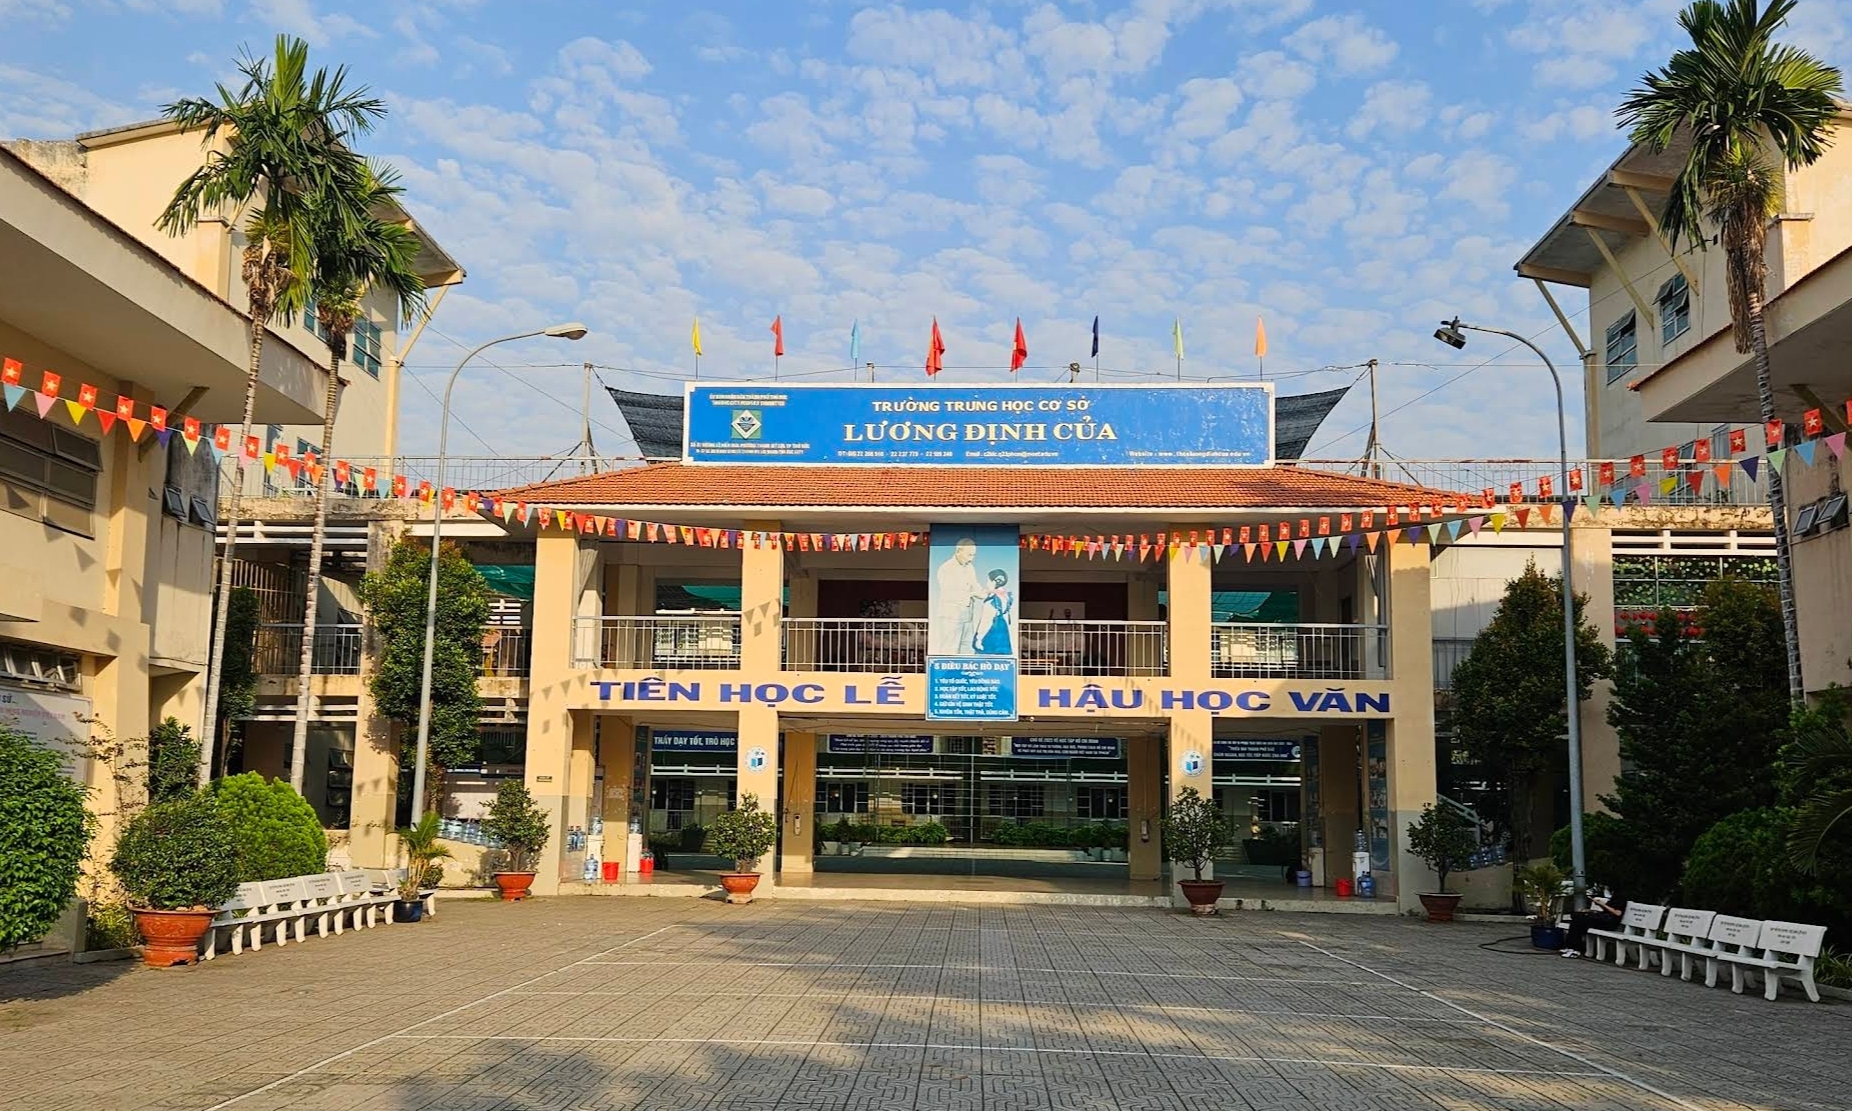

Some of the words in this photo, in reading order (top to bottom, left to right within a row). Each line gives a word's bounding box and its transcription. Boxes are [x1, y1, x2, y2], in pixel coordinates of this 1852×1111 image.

[872, 396, 940, 412] TRƯỜNG
[946, 400, 998, 412] TRUNG
[1002, 400, 1034, 415] HỌC
[1038, 399, 1063, 412] CƠ
[1066, 396, 1091, 411] SỞ
[844, 420, 959, 442] LƯƠNG
[964, 422, 1047, 446] ĐỊNH
[1052, 415, 1118, 441] CỦA
[934, 662, 940, 670] 5
[962, 661, 979, 670] BÁC
[980, 661, 992, 670] HỒ
[720, 683, 825, 708] HỌC
[844, 675, 906, 705] LỄ
[1038, 684, 1143, 713] HẬU
[1161, 690, 1271, 715] HỌC
[1288, 687, 1391, 713] VĂN
[705, 736, 719, 746] TRÒ
[720, 738, 735, 747] HỌC
